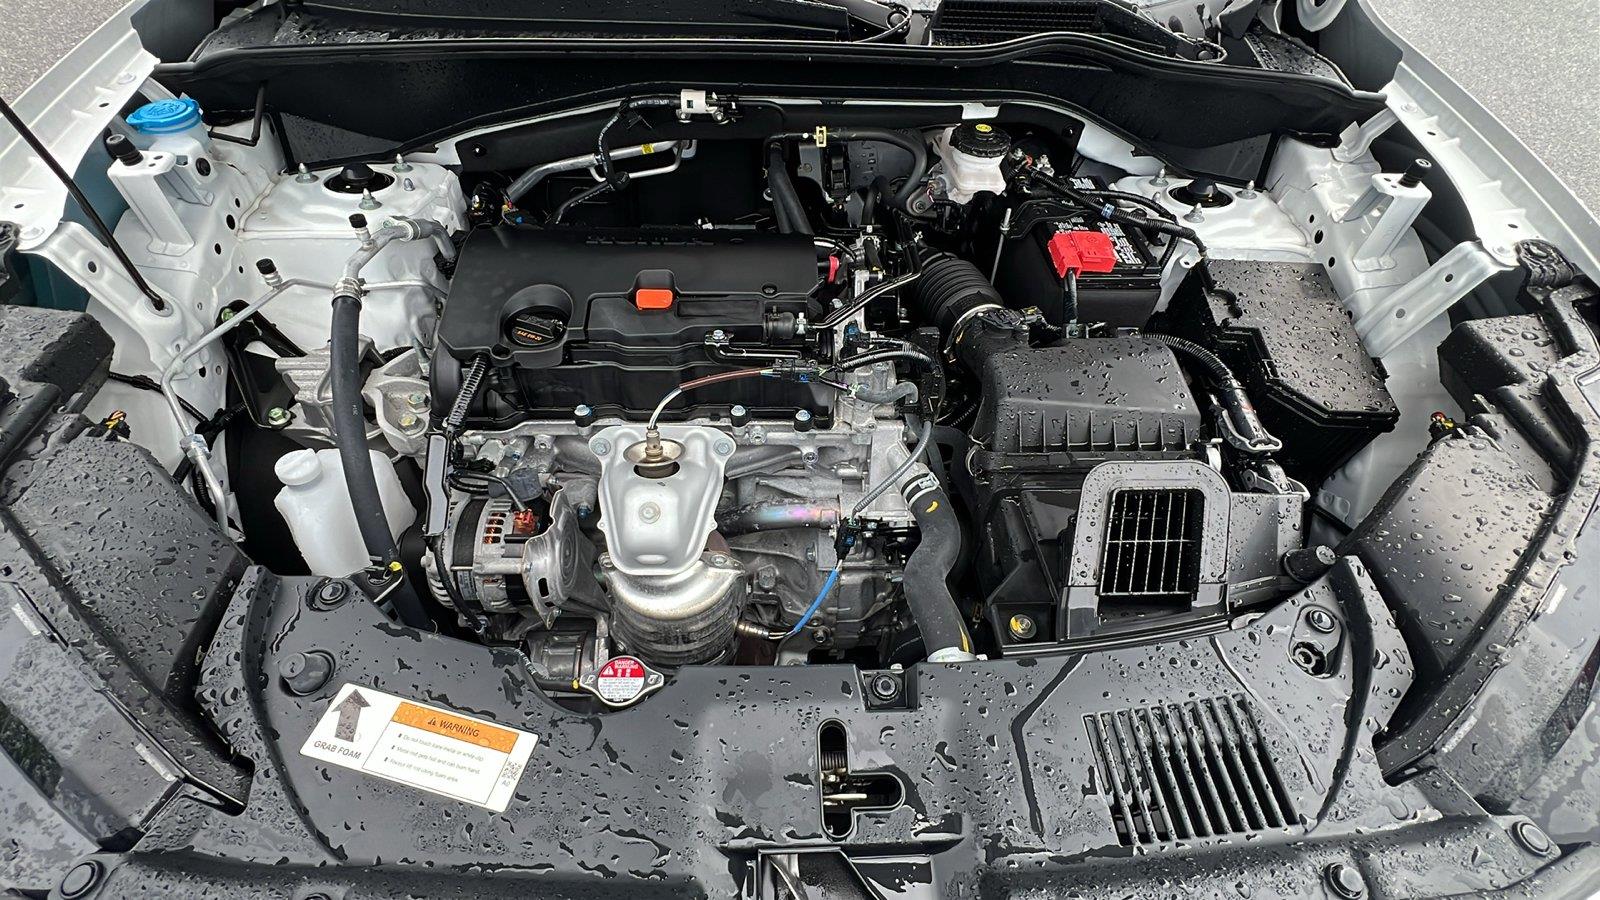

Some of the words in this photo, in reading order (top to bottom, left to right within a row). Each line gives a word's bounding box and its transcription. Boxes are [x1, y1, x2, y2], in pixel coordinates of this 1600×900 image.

[440, 720, 480, 737] WARNING
[314, 740, 336, 754] GRAB
[337, 747, 362, 760] FOAM
